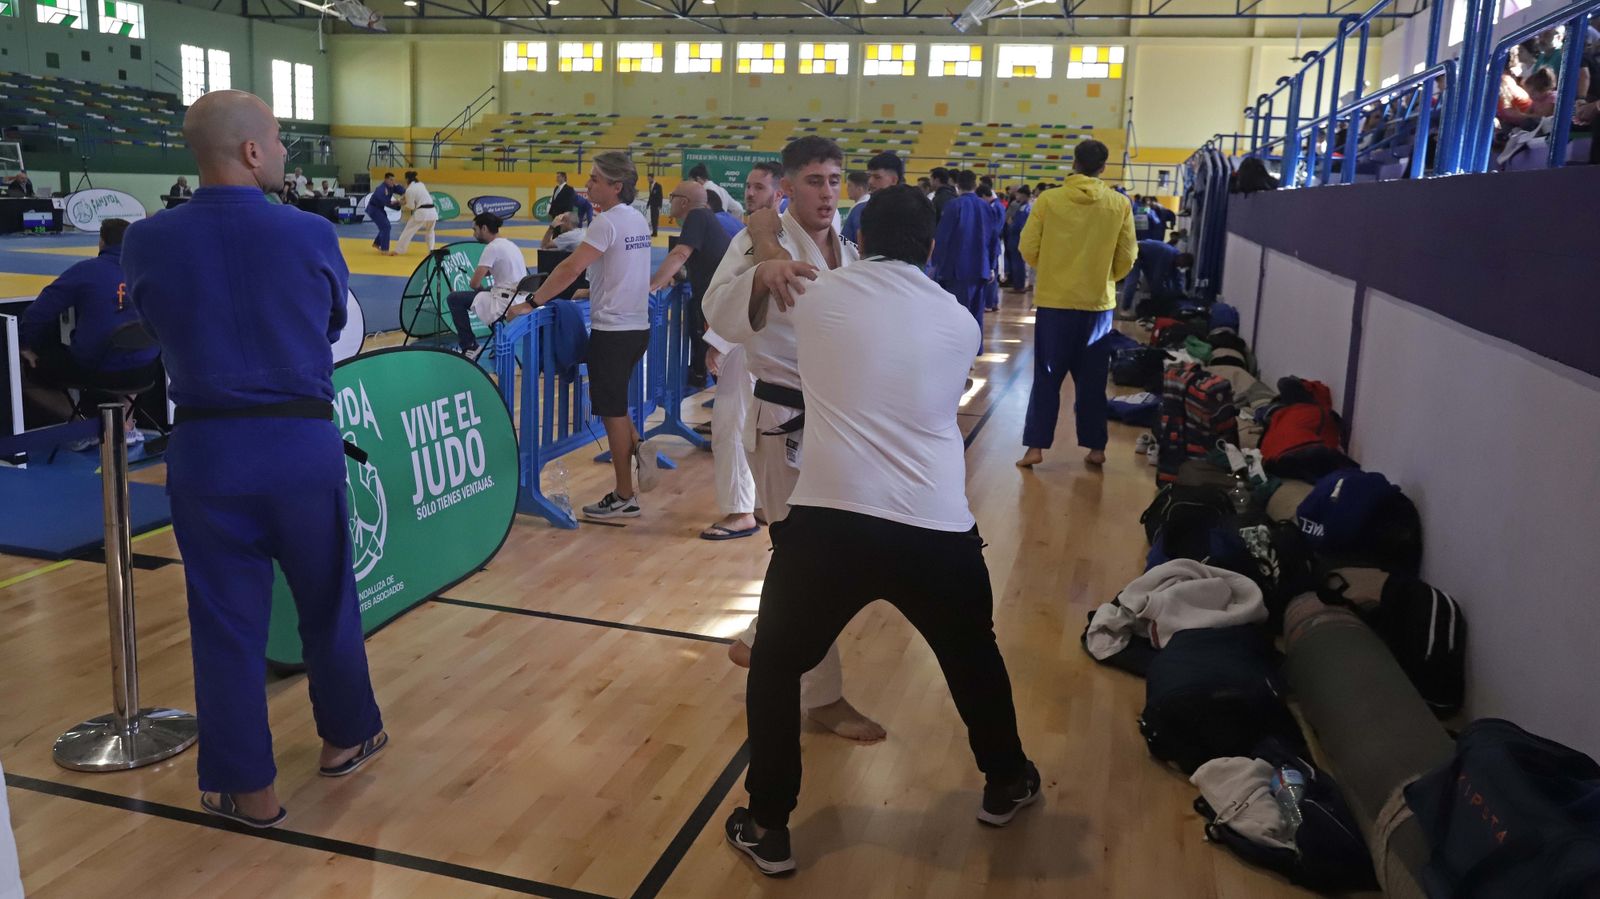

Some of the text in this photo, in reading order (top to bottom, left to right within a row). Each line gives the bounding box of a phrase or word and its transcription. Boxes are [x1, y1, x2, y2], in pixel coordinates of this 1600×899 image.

[331, 378, 383, 441] YDA
[400, 390, 482, 449] VIVE EL
[411, 428, 486, 506] JUDO
[416, 475, 495, 521] SÓLO TIENES VENTAJAS.
[358, 574, 395, 601] NDALUZA DE
[372, 581, 405, 605] ASOCIADOS
